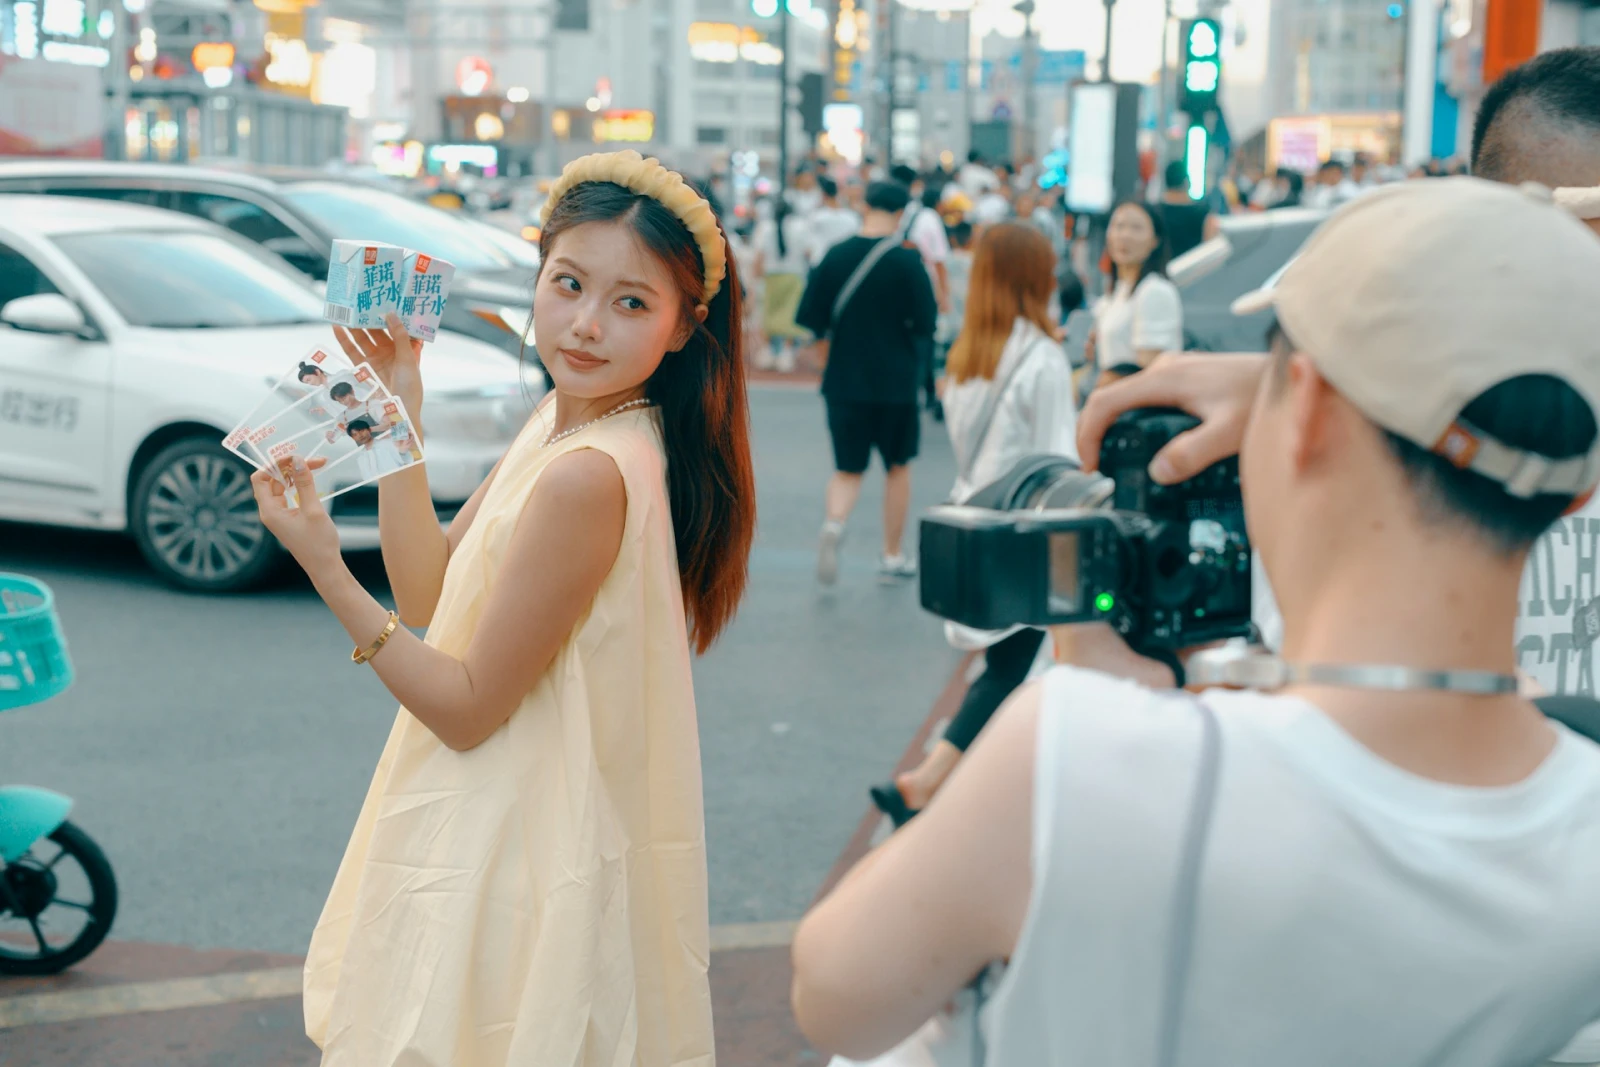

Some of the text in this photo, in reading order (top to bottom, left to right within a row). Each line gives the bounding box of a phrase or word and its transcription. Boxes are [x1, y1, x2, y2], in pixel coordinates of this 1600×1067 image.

[364, 261, 394, 288] 菲诺
[412, 274, 442, 294] 菲诺
[357, 281, 401, 313] 椰子水
[402, 294, 447, 316] 椰子水
[1519, 517, 1600, 617] ICH
